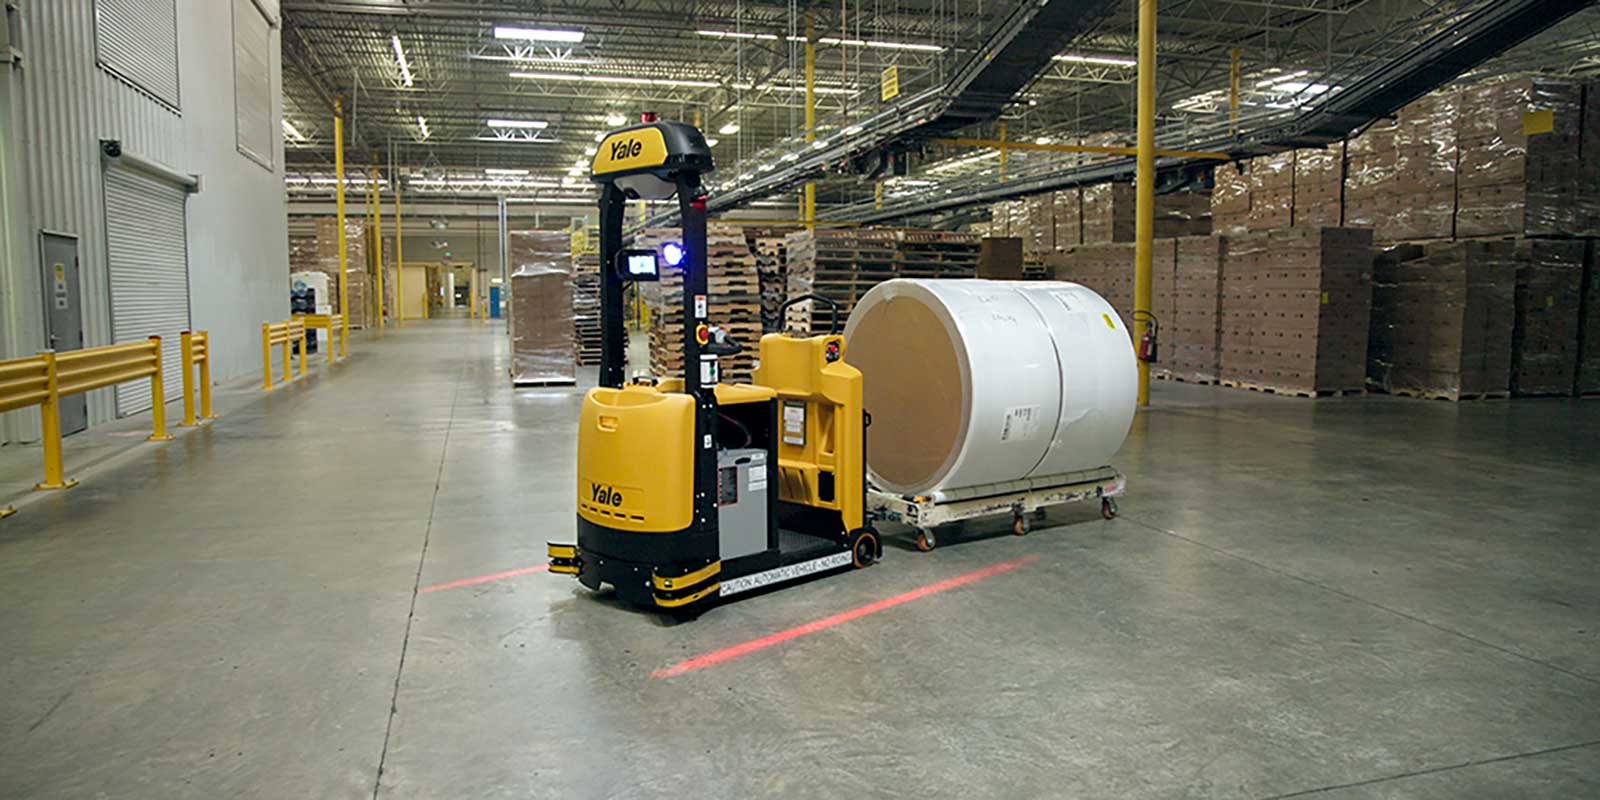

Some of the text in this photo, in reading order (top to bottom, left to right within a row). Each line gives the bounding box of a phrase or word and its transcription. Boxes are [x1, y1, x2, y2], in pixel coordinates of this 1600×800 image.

[610, 139, 642, 161] Yale
[591, 483, 622, 507] Yale
[721, 579, 753, 593] CAUTION
[753, 567, 791, 585] AUTOMATIC
[791, 561, 817, 577] VEHICLE
